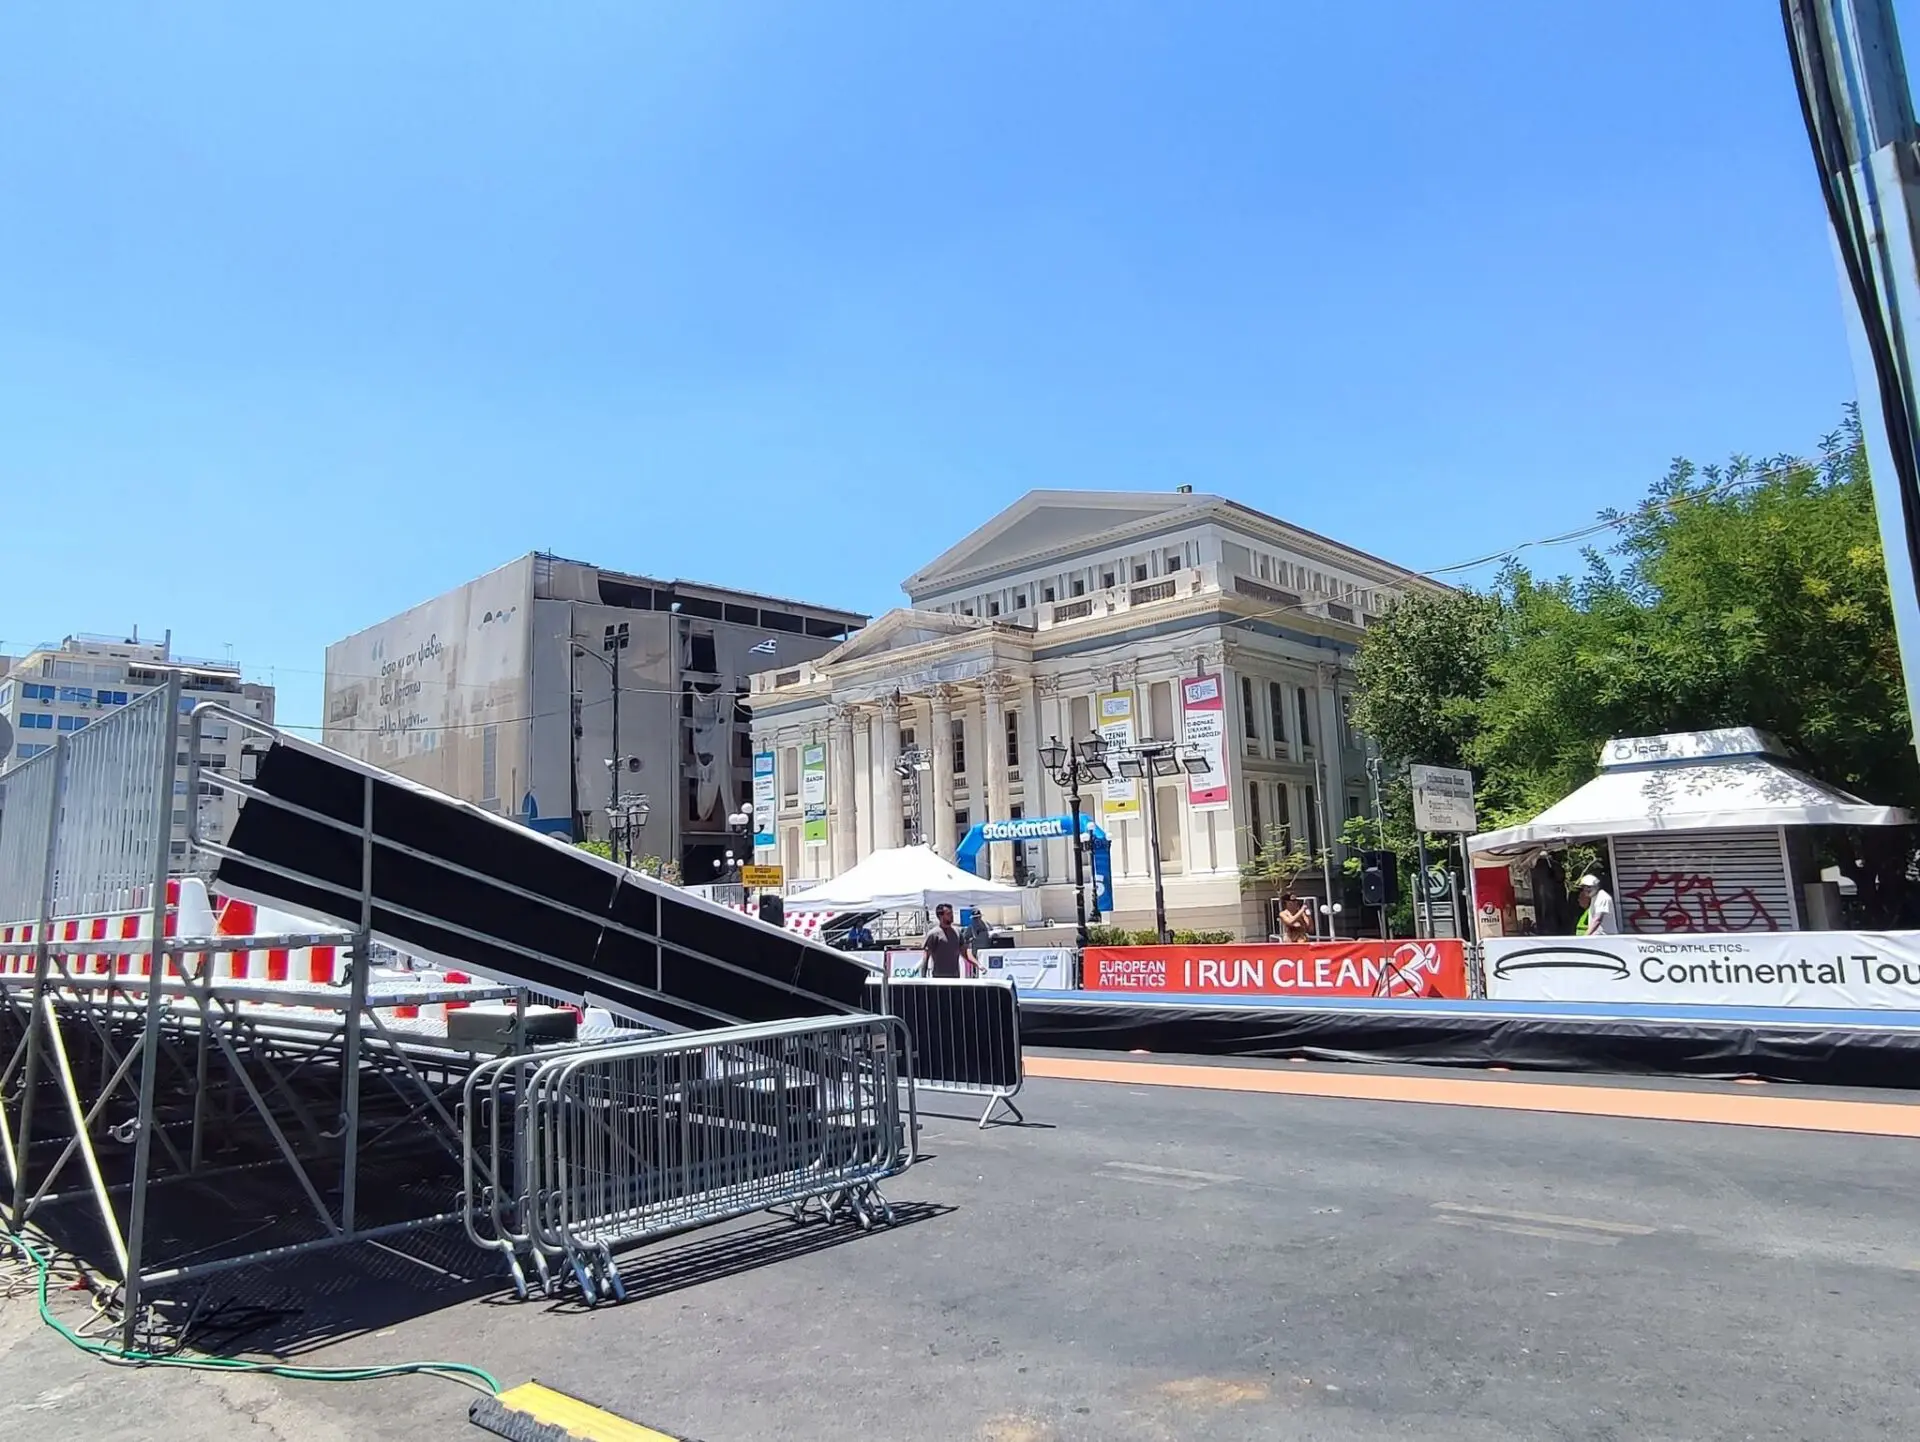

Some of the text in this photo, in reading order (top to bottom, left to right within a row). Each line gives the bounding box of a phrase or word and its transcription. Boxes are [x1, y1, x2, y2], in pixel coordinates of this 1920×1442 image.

[1638, 944, 1743, 954] WORLD ATHLETICS
[1099, 960, 1166, 973] EUROPEAN
[1184, 958, 1387, 988] I RUN CLEAN
[1640, 956, 1845, 984] Continental
[1099, 973, 1166, 986] ATHLETICS
